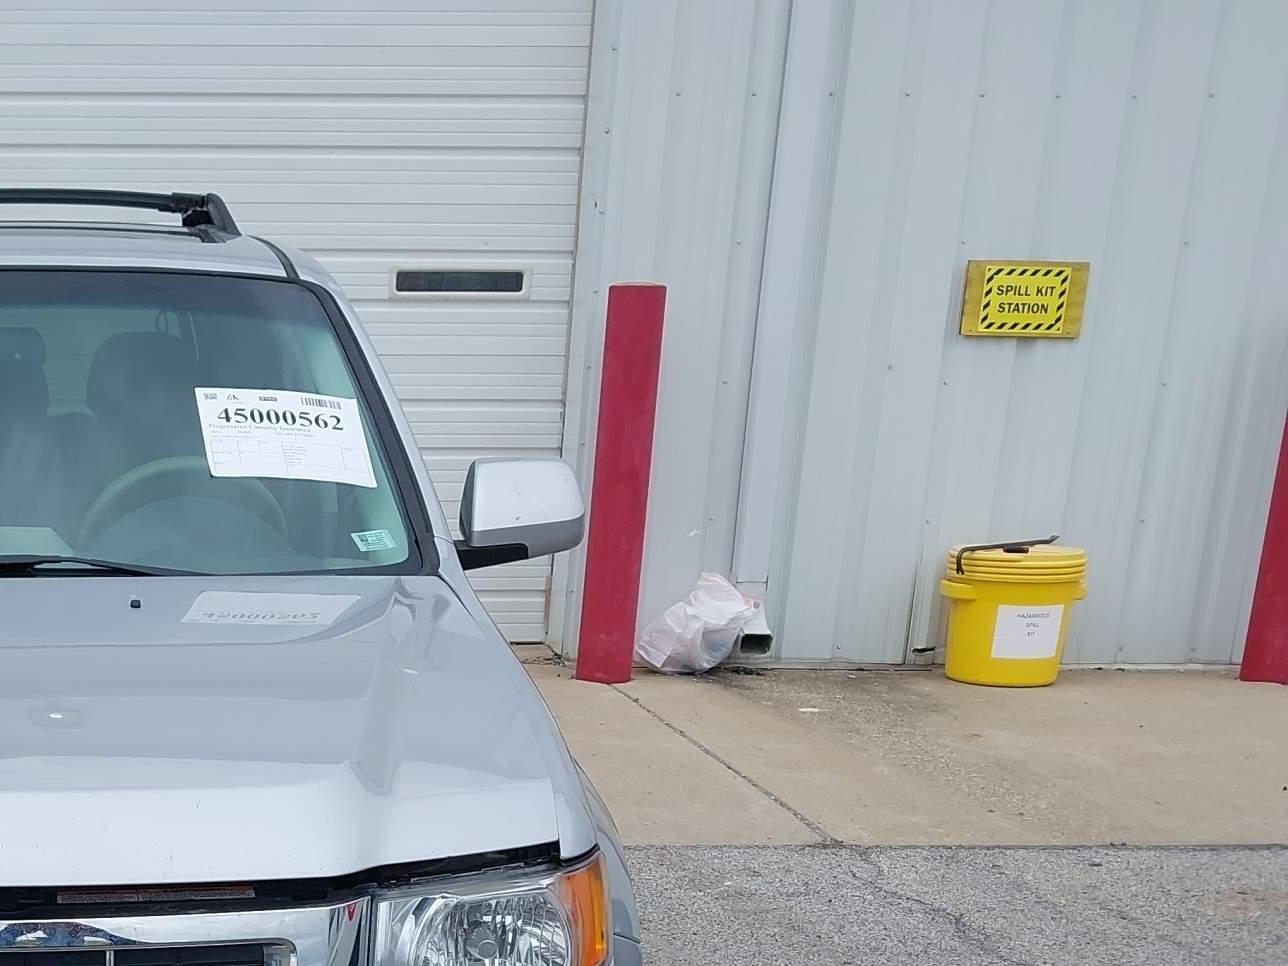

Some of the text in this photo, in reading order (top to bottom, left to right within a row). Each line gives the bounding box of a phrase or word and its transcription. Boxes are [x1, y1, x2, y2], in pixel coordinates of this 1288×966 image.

[996, 285, 1057, 297] SPILL KIT
[998, 303, 1049, 314] STATION
[217, 407, 345, 431] 45000562
